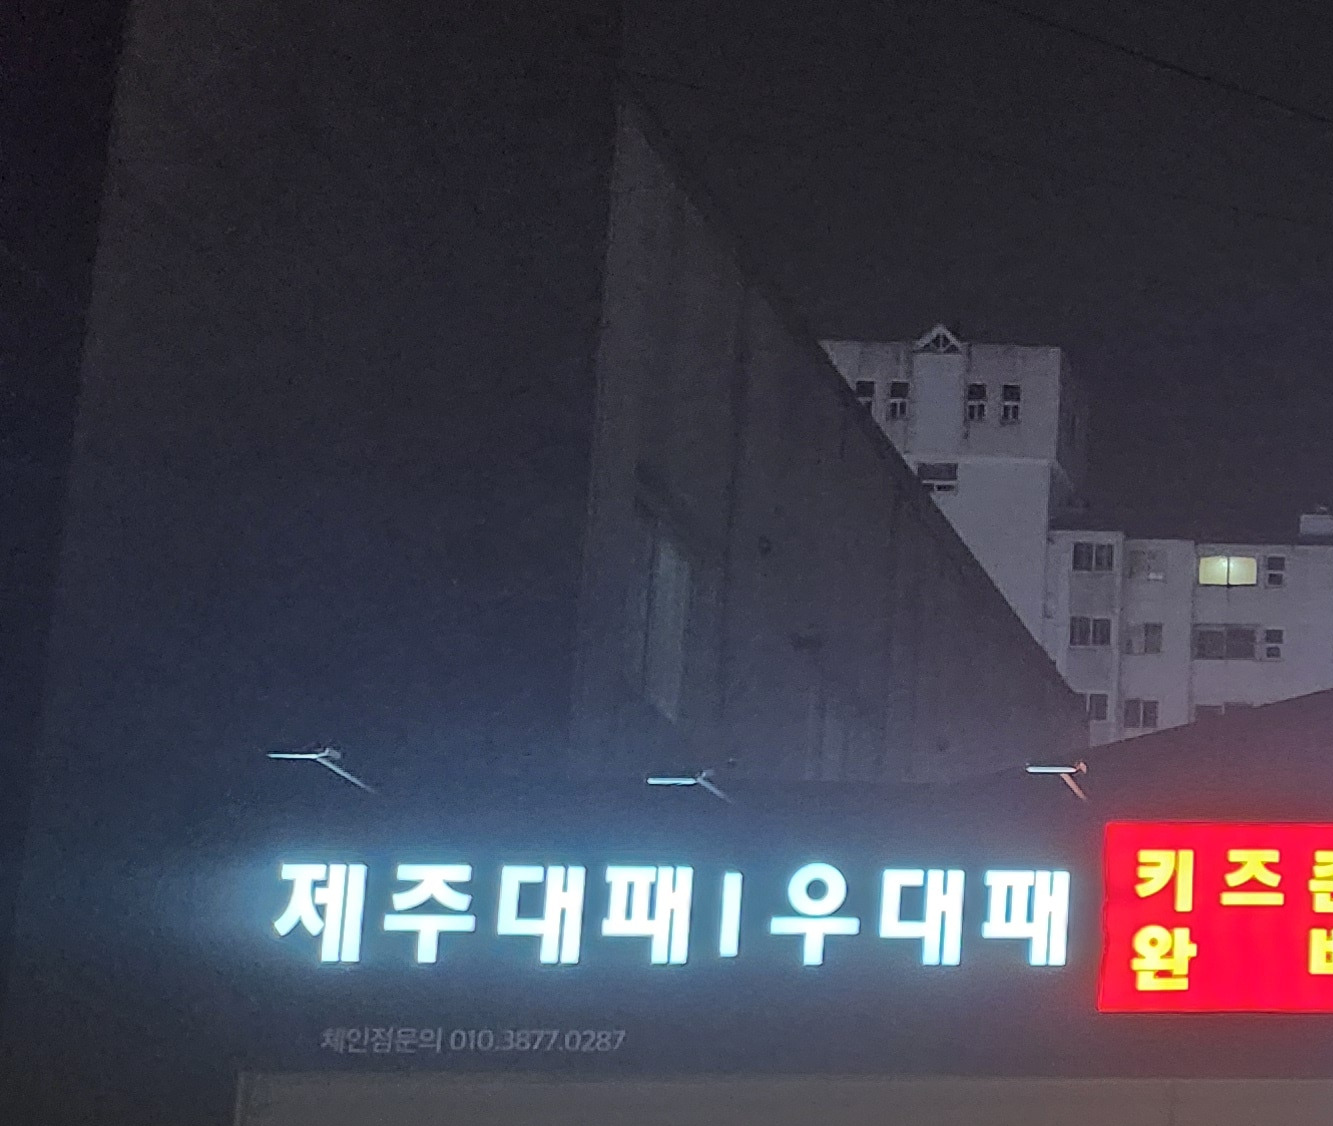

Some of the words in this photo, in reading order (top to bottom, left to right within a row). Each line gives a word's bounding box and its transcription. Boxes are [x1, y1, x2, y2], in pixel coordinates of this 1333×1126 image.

[274, 860, 695, 966] 제주대패
[769, 861, 1072, 967] 우대패
[320, 1027, 442, 1053] 체인점문의
[450, 1029, 627, 1051] 010.3877.0287
